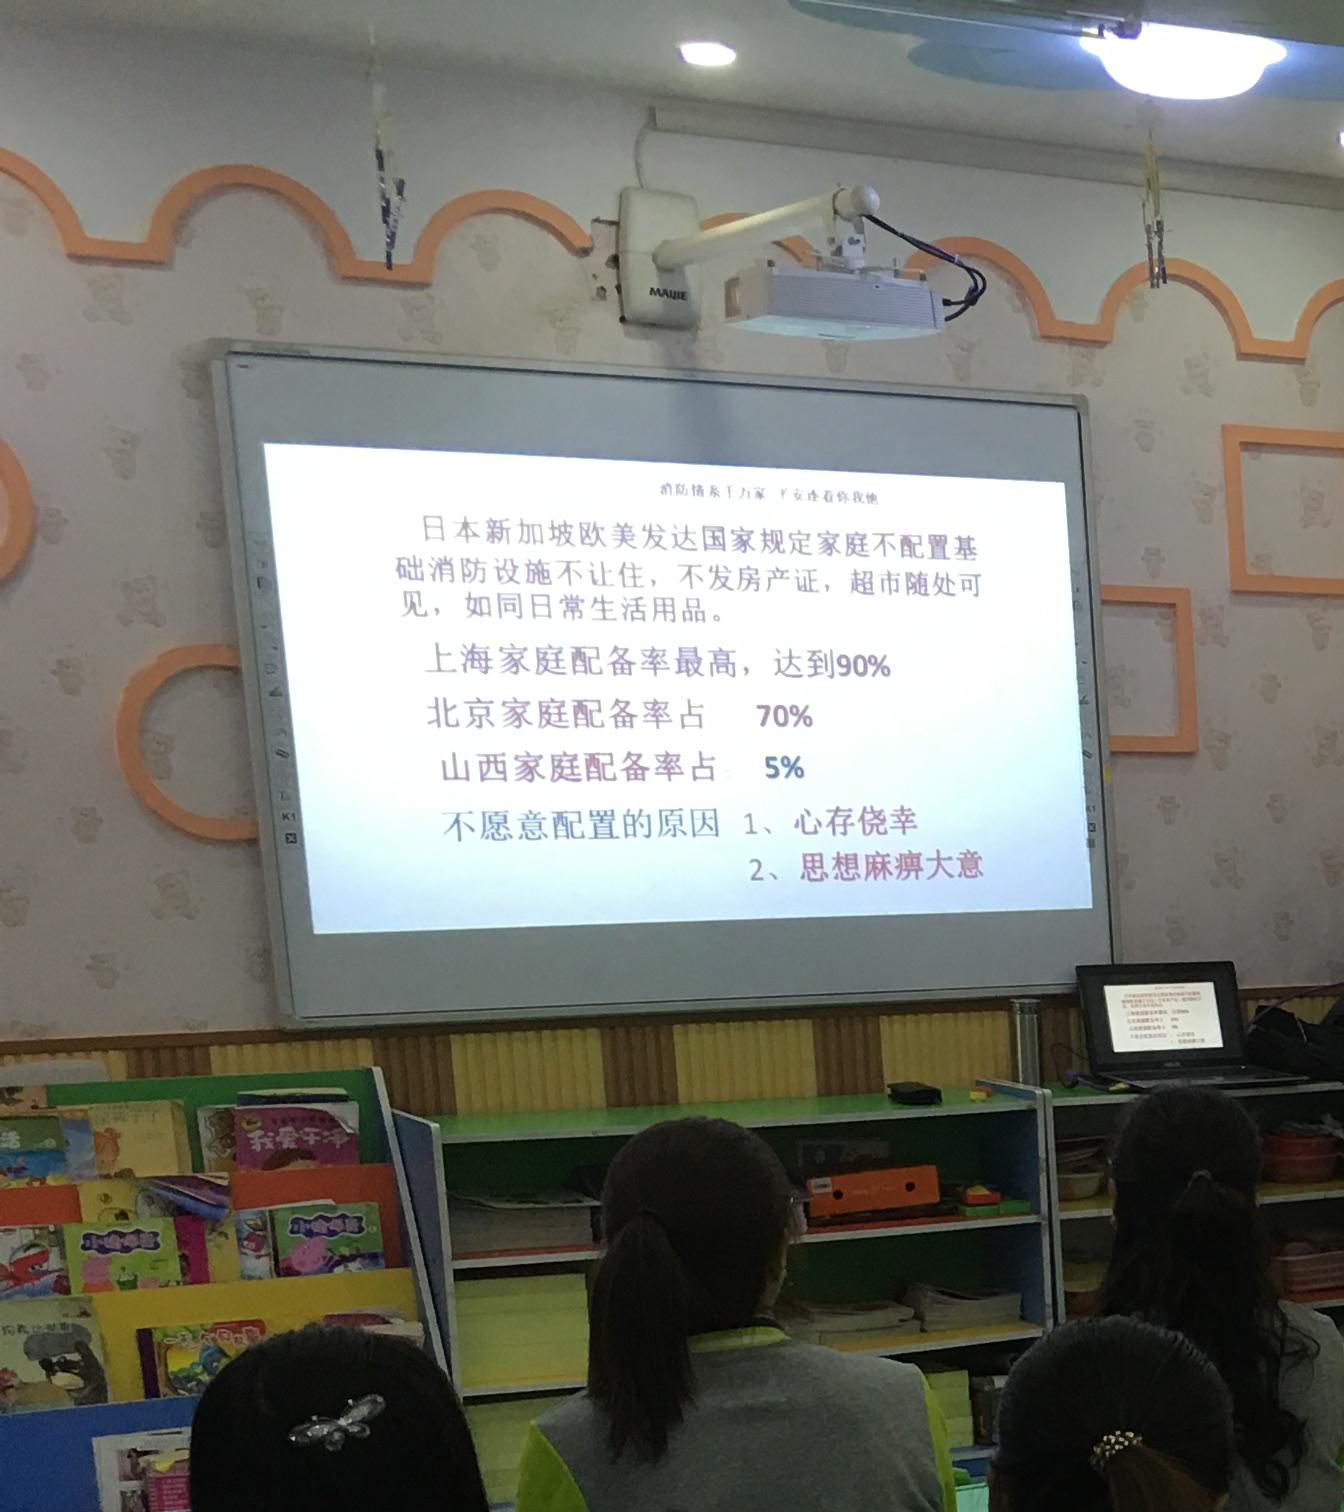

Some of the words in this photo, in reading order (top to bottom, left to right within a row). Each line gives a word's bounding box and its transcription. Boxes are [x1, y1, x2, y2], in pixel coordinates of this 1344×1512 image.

[423, 514, 978, 561] 日本新加坡欧美发达国家规定家庭不配置基
[427, 696, 704, 730] 北京家庭配备率占
[756, 703, 813, 727] 70%
[441, 750, 715, 783] 山西家庭配备率占
[765, 755, 805, 779] 5%
[441, 808, 720, 842] 不愿意配置的原因
